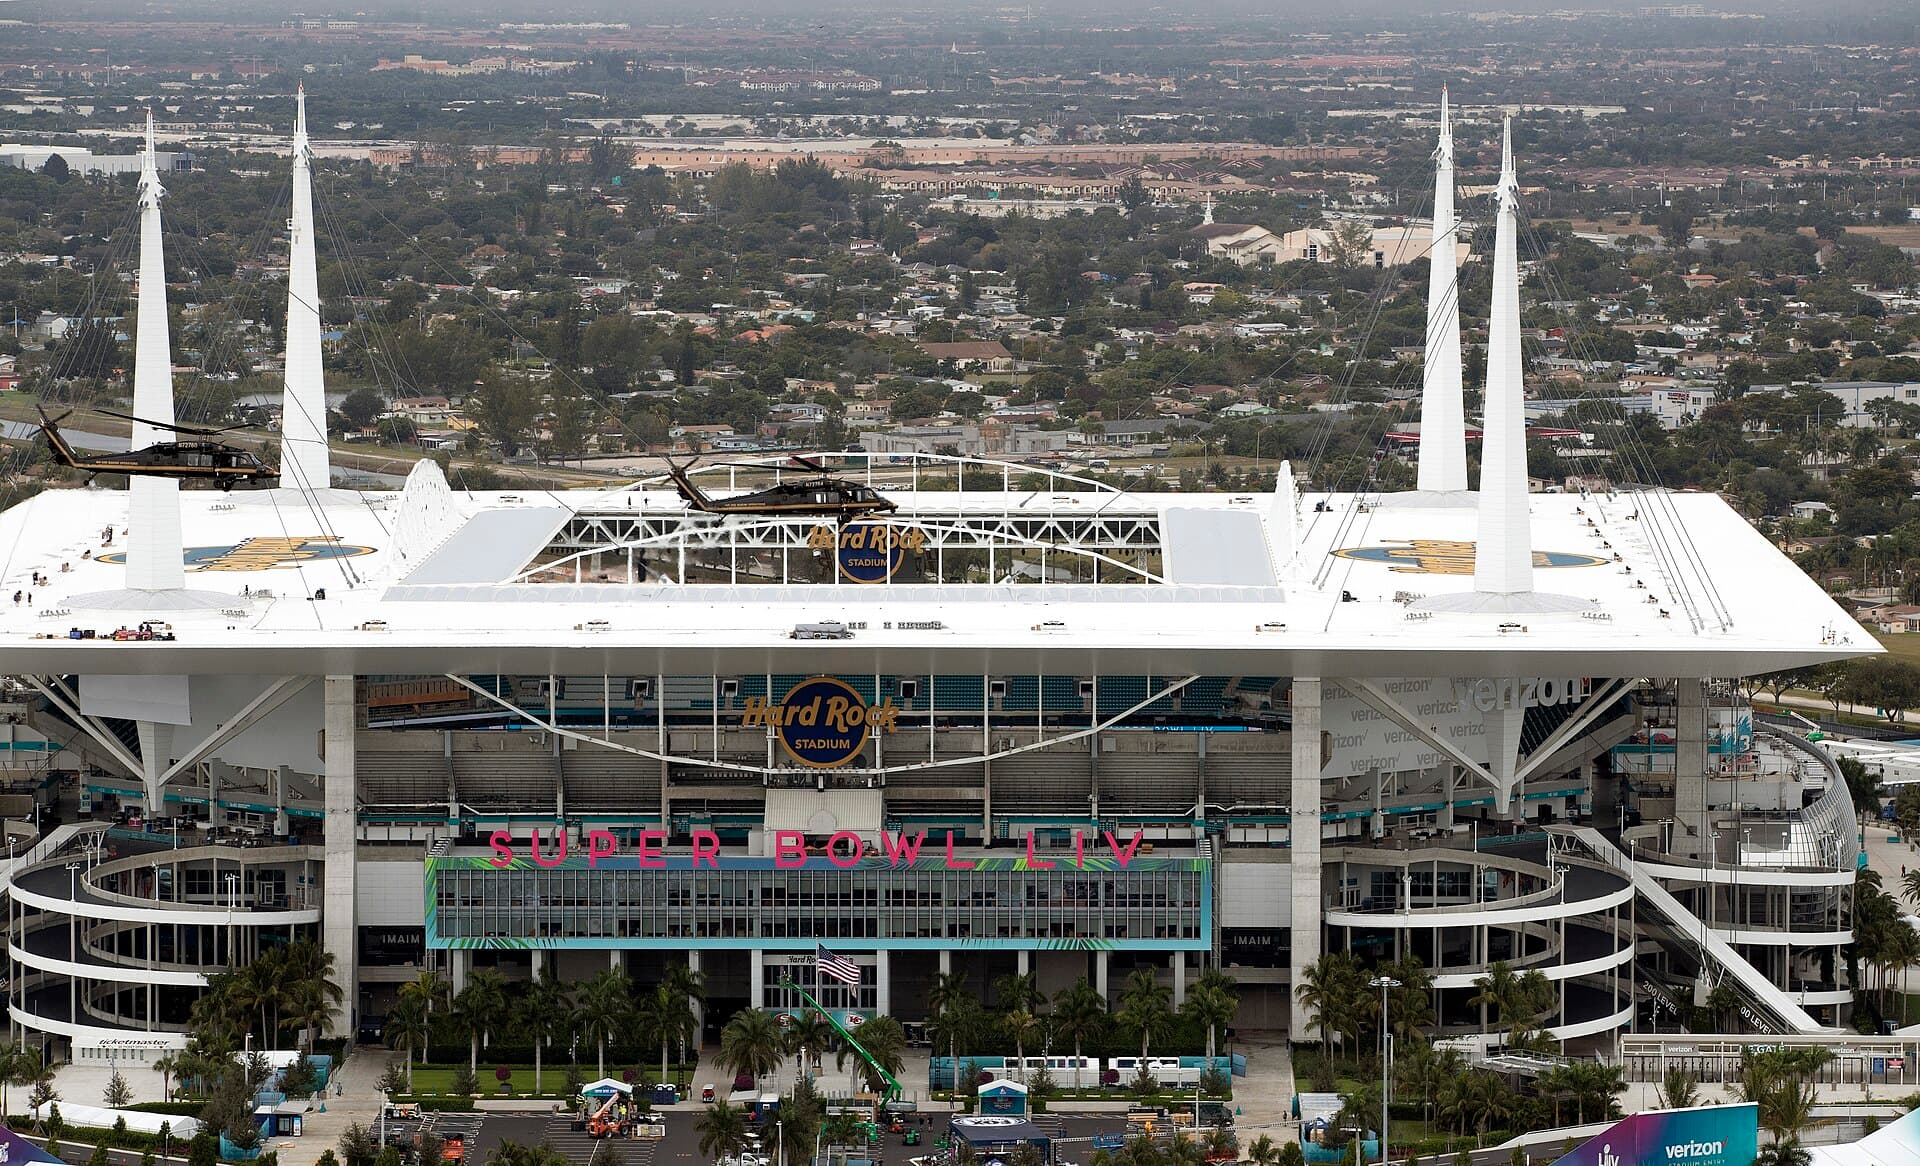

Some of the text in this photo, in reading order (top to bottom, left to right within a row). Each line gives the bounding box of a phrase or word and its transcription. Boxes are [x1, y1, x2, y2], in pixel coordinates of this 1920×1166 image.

[808, 525, 925, 554] Hard Rock
[848, 558, 888, 567] STADIUM
[1384, 680, 1430, 694] verizon
[1453, 677, 1582, 711] verizon
[742, 696, 900, 733] Hard Rock
[795, 738, 850, 749] STADIUM
[1332, 734, 1363, 749] rizon
[1351, 755, 1395, 771] verizon
[489, 830, 1144, 869] SUPER BOWL LIV
[1233, 935, 1271, 945] IMAIM
[806, 956, 817, 964] Ro
[1643, 980, 1678, 1016] 200 LEVEL
[1739, 1006, 1751, 1018] 00
[98, 1038, 170, 1046] ticketmaster
[1830, 1046, 1855, 1054] verizon
[1665, 1140, 1722, 1159] verizon
